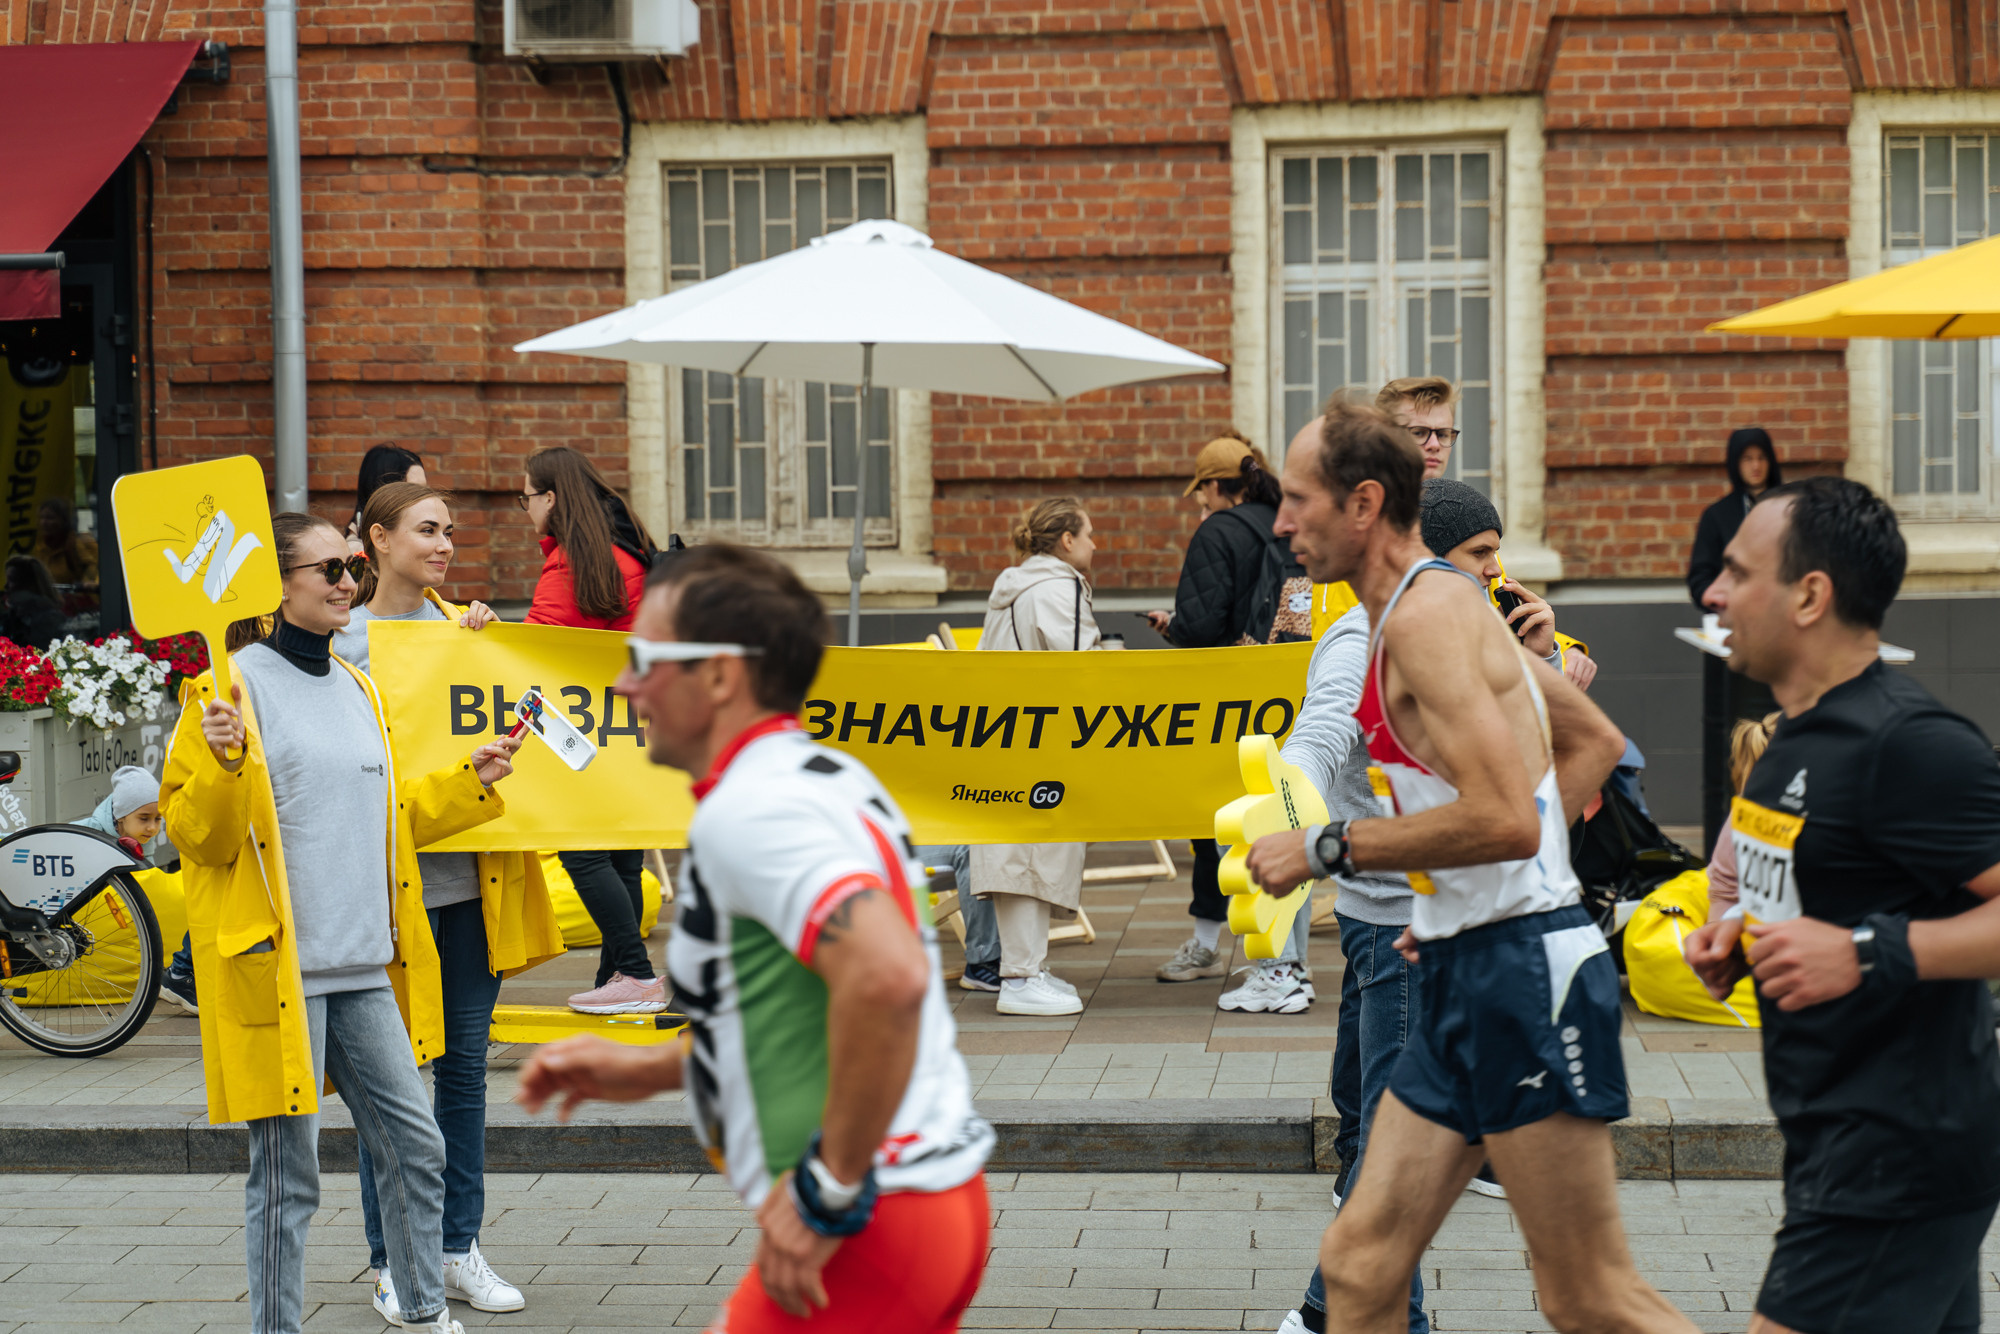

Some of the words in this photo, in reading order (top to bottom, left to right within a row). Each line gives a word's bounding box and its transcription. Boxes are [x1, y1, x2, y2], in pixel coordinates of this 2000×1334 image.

[804, 699, 1059, 748] ЗНАЧИТ
[1071, 702, 1200, 748] УЖЕ
[1211, 694, 1306, 745] ПО
[951, 784, 1025, 804] Яндекс
[1032, 785, 1060, 804] Go
[33, 854, 75, 877] ВТБ
